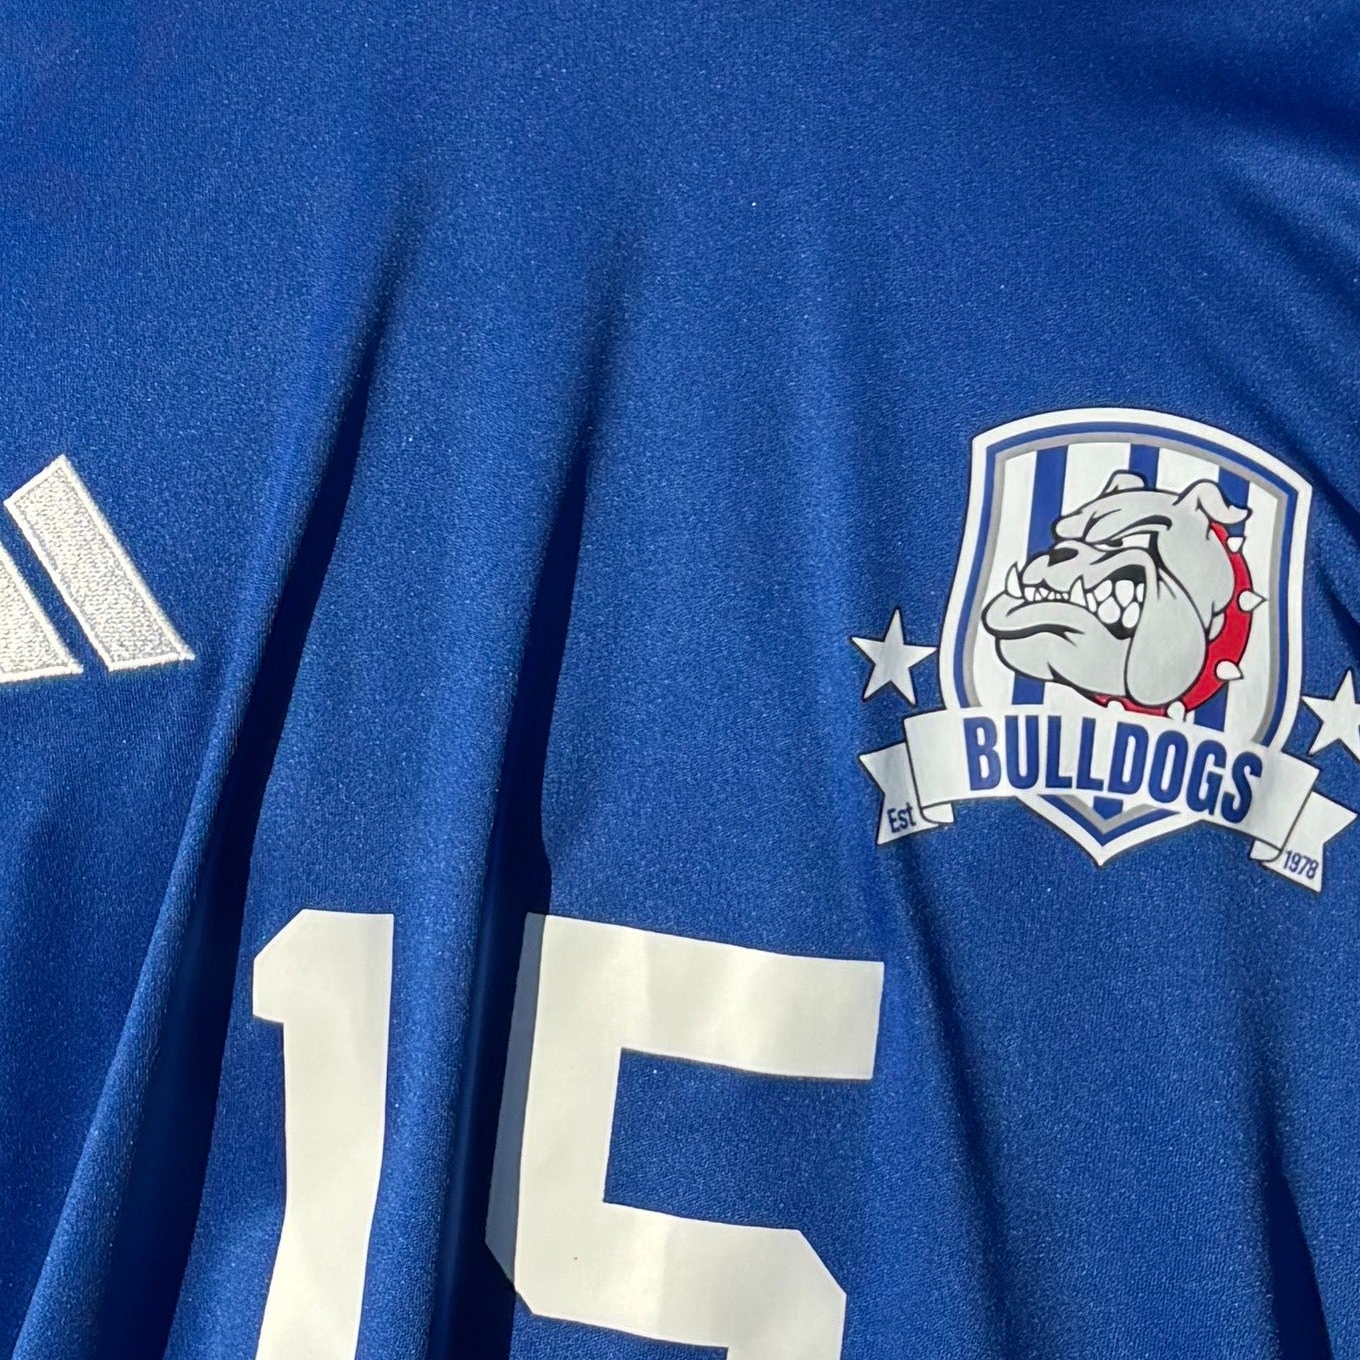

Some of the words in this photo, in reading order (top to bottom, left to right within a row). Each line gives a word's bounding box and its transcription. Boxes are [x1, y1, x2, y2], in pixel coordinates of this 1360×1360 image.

[963, 715, 1262, 824] BULLDOGS
[887, 802, 917, 833] Est
[1283, 850, 1319, 879] 1978
[252, 908, 885, 1360] 15
